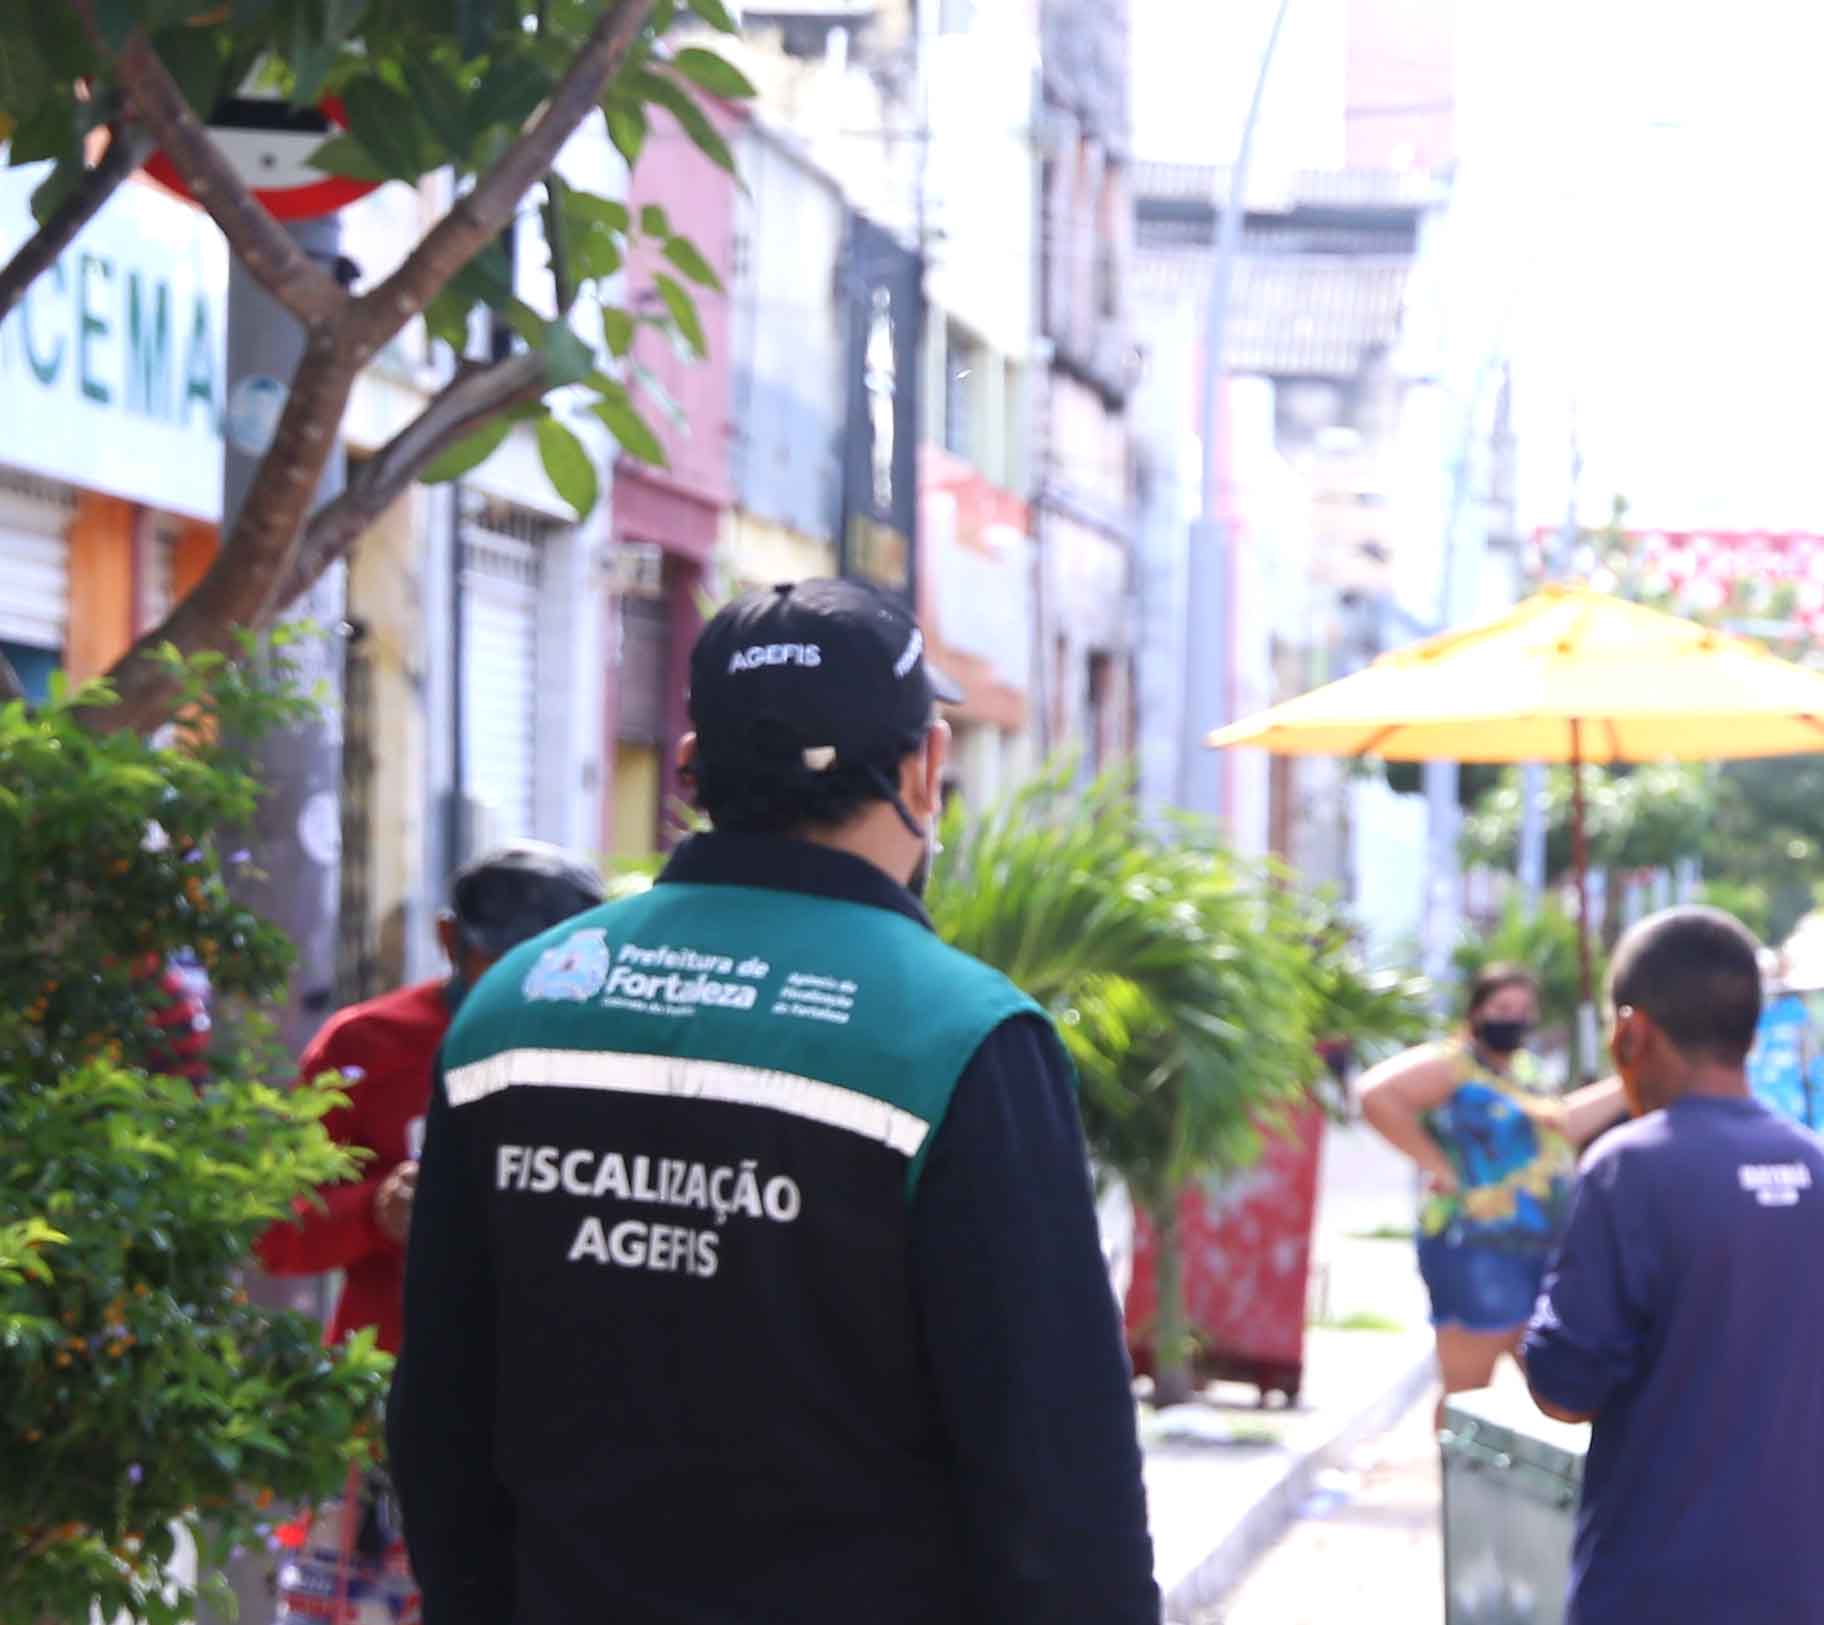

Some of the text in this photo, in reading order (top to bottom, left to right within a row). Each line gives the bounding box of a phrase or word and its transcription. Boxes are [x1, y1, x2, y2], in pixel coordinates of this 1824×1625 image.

[728, 642, 822, 675] AGEFIS
[618, 944, 770, 979] Prefeitura de
[605, 966, 758, 1010] Fortaleza
[496, 1144, 801, 1225] FISCALIZAÇÃO
[566, 1215, 719, 1278] AGEFIS
